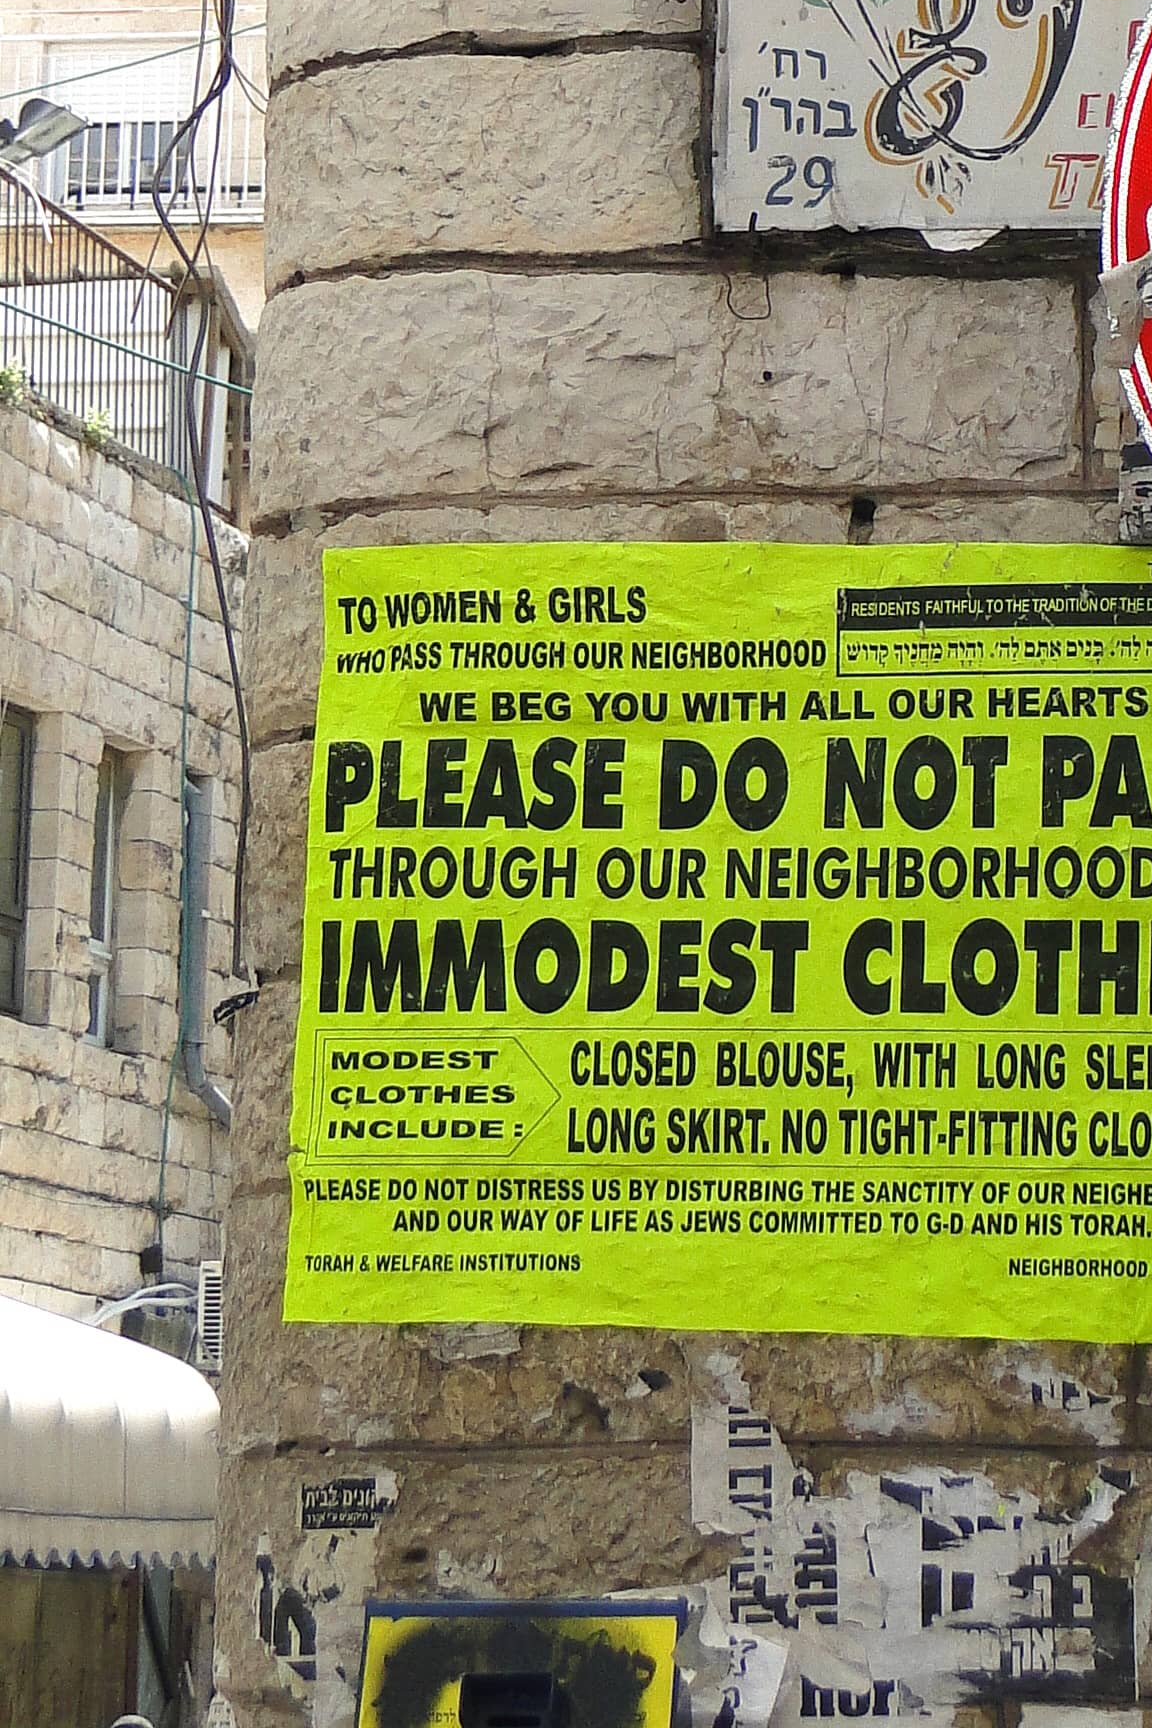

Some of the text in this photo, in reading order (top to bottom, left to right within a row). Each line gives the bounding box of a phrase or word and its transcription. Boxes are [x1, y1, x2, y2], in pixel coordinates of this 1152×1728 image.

[765, 156, 834, 210] 29
[339, 586, 647, 633] TO WOMEN & GIRLS
[851, 601, 920, 617] RESIDENTS
[925, 599, 983, 615] FAITHFUL
[985, 599, 1003, 613] TO
[1005, 598, 1030, 613] THE
[1032, 597, 1097, 613] TRADITION
[1100, 597, 1117, 612] OF
[1119, 597, 1144, 613] THE
[337, 639, 827, 674] WHO PASS THROUGH OUR NEIGHBORHOOD
[420, 686, 1149, 722] WE BEG YOU WITH ALL OUR HEARTS
[325, 736, 626, 834] PLEASE
[659, 736, 789, 832] DO
[823, 735, 1009, 831] NOT
[329, 845, 577, 900] THROUGH
[597, 846, 705, 900] OUR
[318, 918, 809, 1014] IMMODEST
[331, 1050, 499, 1070] MODEST
[571, 1040, 697, 1088] CLOSED
[716, 1040, 855, 1098] BLOUSE,
[874, 1042, 957, 1089] WITH
[977, 1043, 1066, 1090] LONG
[330, 1083, 516, 1105] CLOTHES
[568, 1107, 656, 1154] LONG
[667, 1108, 769, 1155] SKIRT.
[782, 1109, 828, 1155] NO
[839, 1109, 1077, 1158] TIGHT-FITTING
[304, 1178, 381, 1202] PLEASE
[388, 1179, 418, 1202] DO
[423, 1179, 470, 1202] NOT
[477, 1179, 584, 1202] DISTRESS
[593, 1179, 622, 1203] US
[629, 1180, 659, 1203] BY
[666, 1180, 804, 1204] DISTURBING
[812, 1181, 855, 1204] THE
[863, 1181, 975, 1205] SANCTITY
[981, 1182, 1011, 1205] OF
[1018, 1183, 1066, 1206] OUR
[394, 1210, 1152, 1239] AND OUR WAY OF LIFE AS JEWS COMMITTED TO G-D AND HIS TORAH.
[305, 1255, 354, 1273] TORAH
[359, 1255, 370, 1273] &
[376, 1254, 453, 1273] WELFARE
[460, 1255, 581, 1272] INSTITUTIONS
[1008, 1258, 1147, 1278] NEIGHBORHOOD
